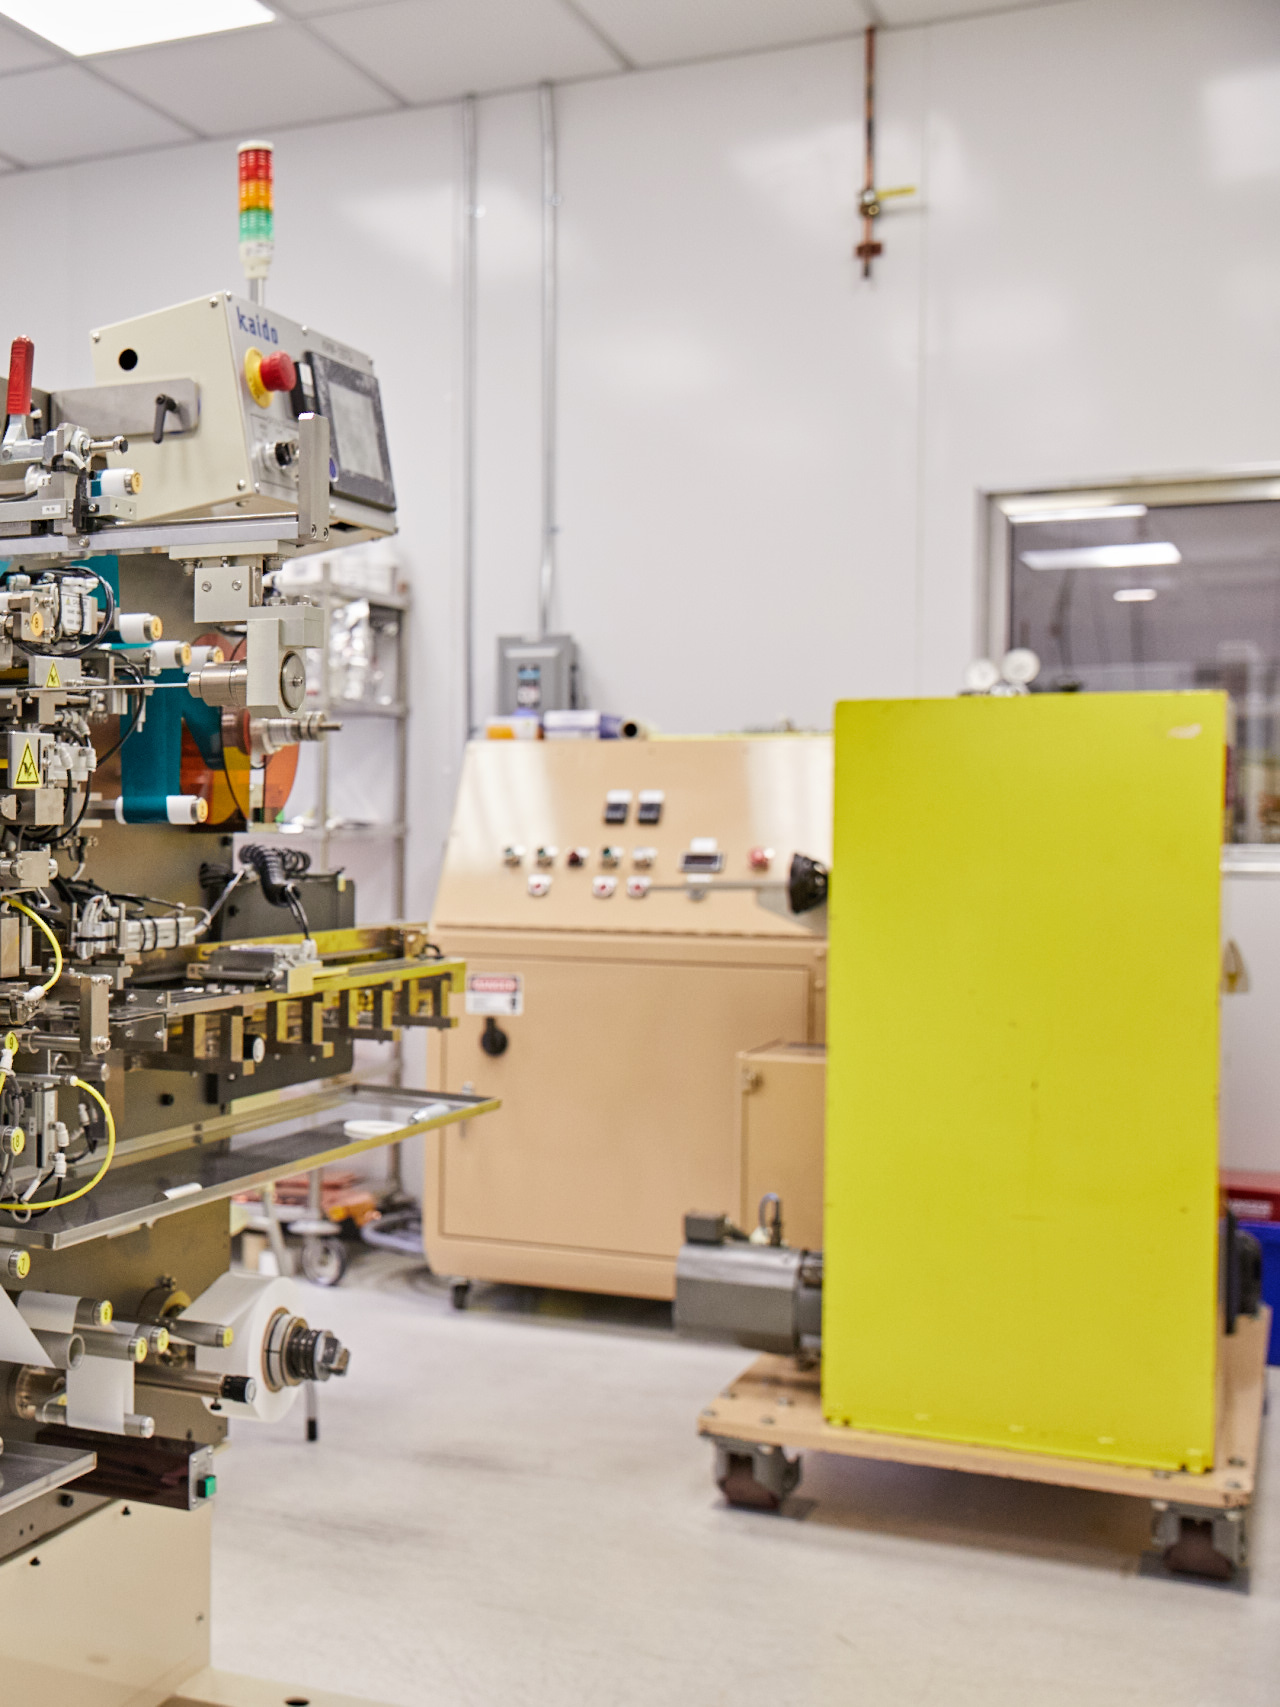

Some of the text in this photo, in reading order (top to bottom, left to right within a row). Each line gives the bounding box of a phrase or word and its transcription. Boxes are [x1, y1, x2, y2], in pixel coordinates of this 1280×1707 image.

[236, 305, 279, 346] kaido
[9, 1037, 14, 1049] 9
[15, 1135, 20, 1148] 8
